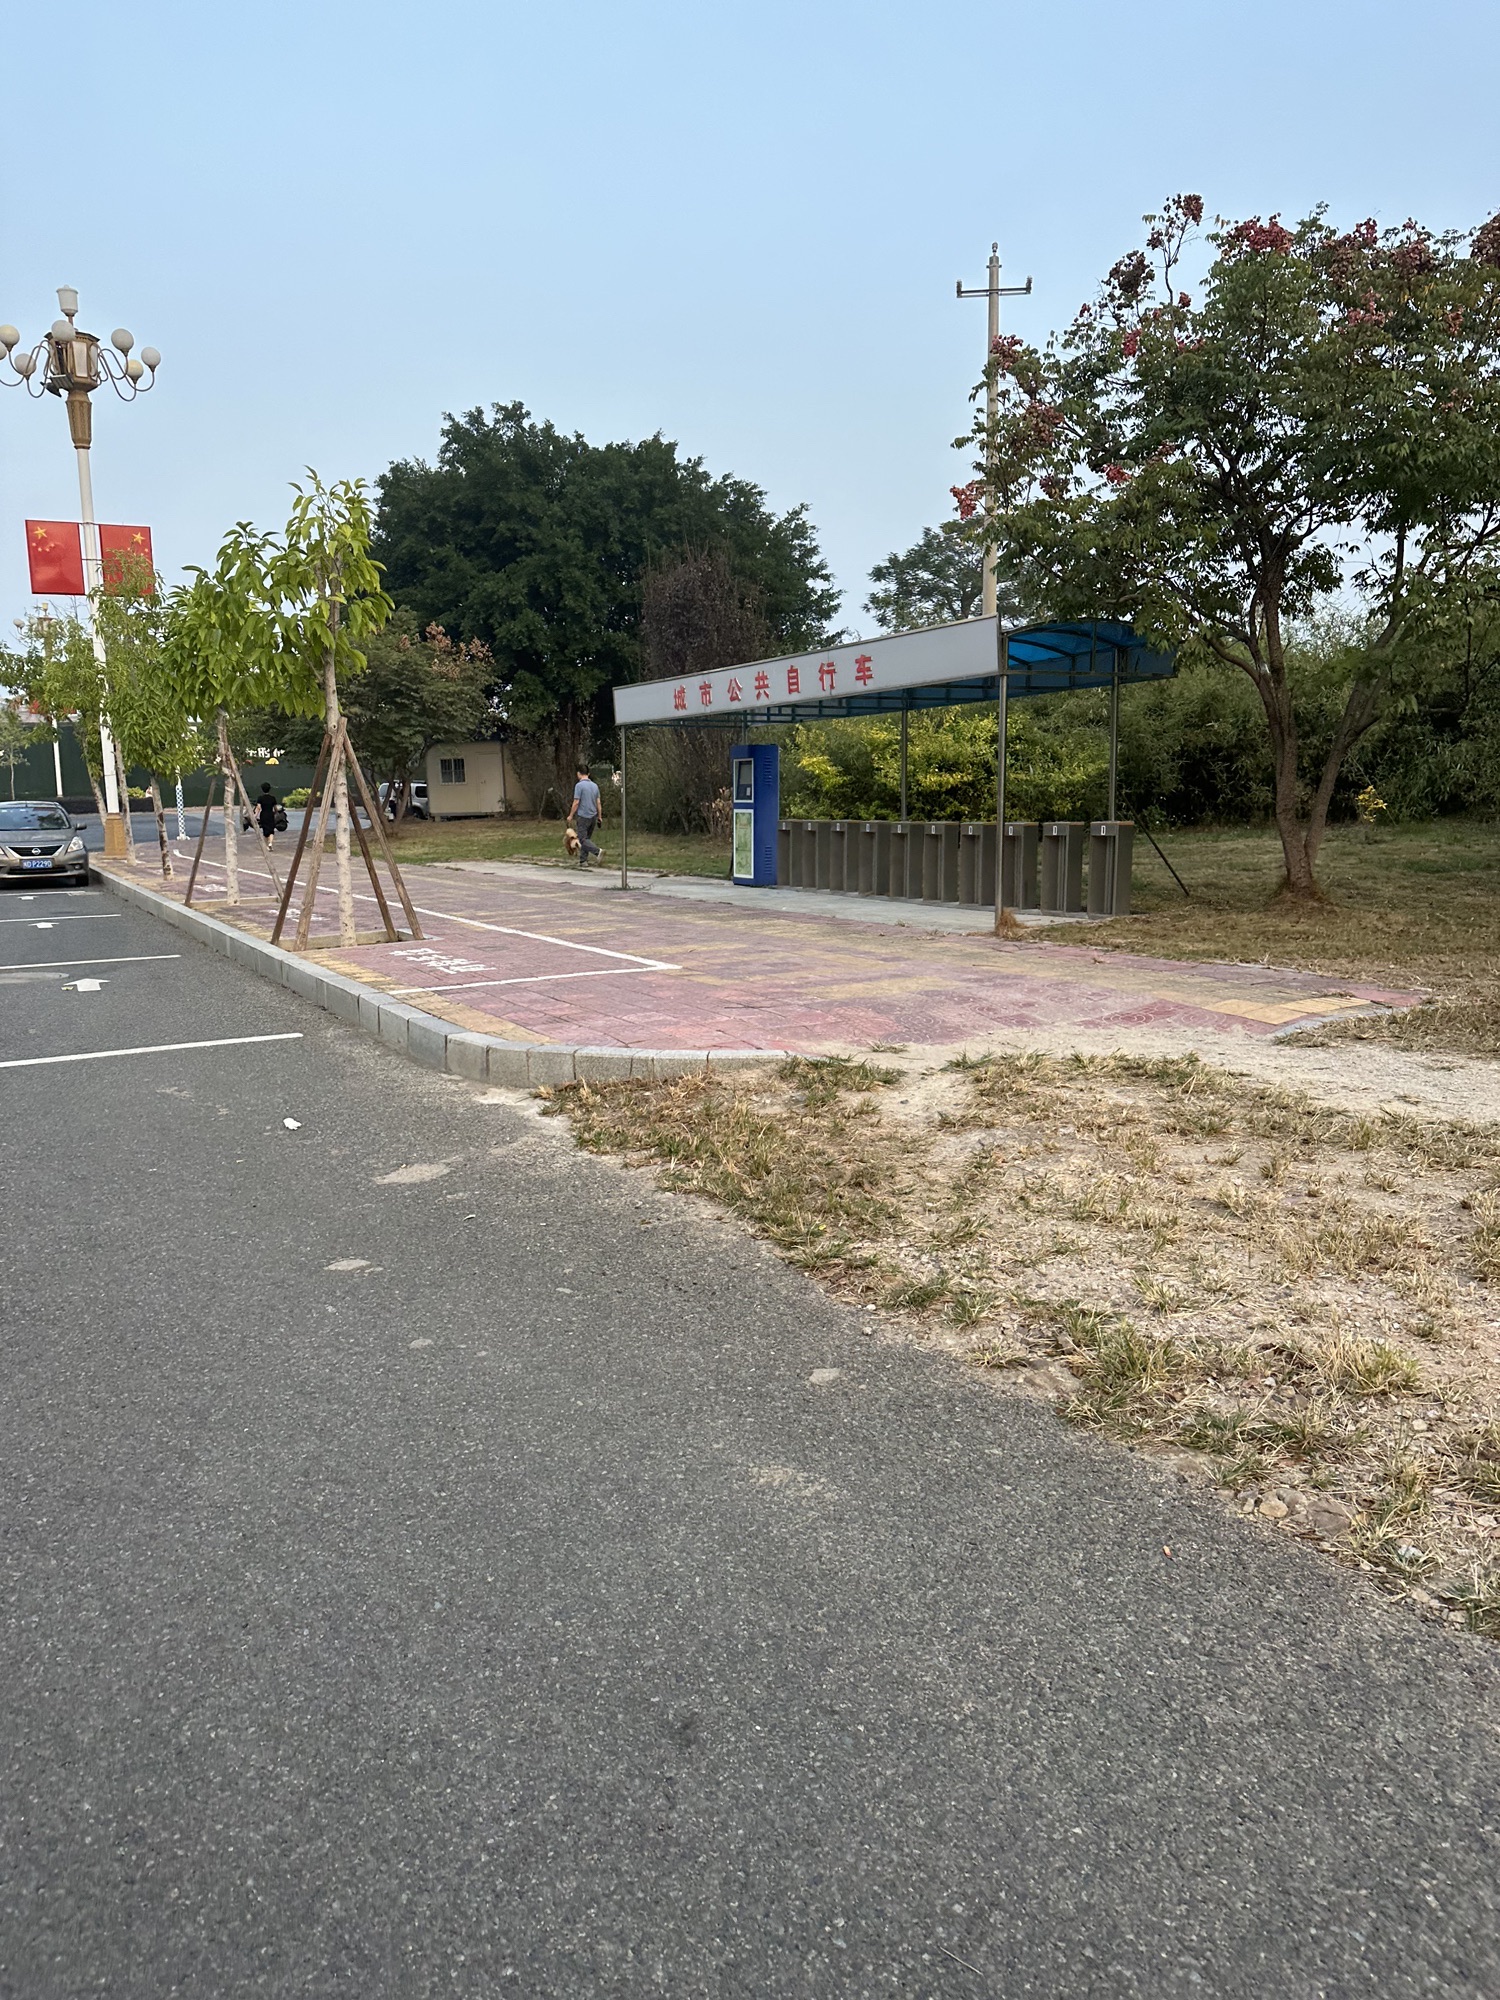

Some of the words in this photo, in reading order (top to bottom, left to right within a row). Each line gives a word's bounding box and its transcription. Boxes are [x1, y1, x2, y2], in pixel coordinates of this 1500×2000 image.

[674, 654, 874, 710] 城市公共自行车
